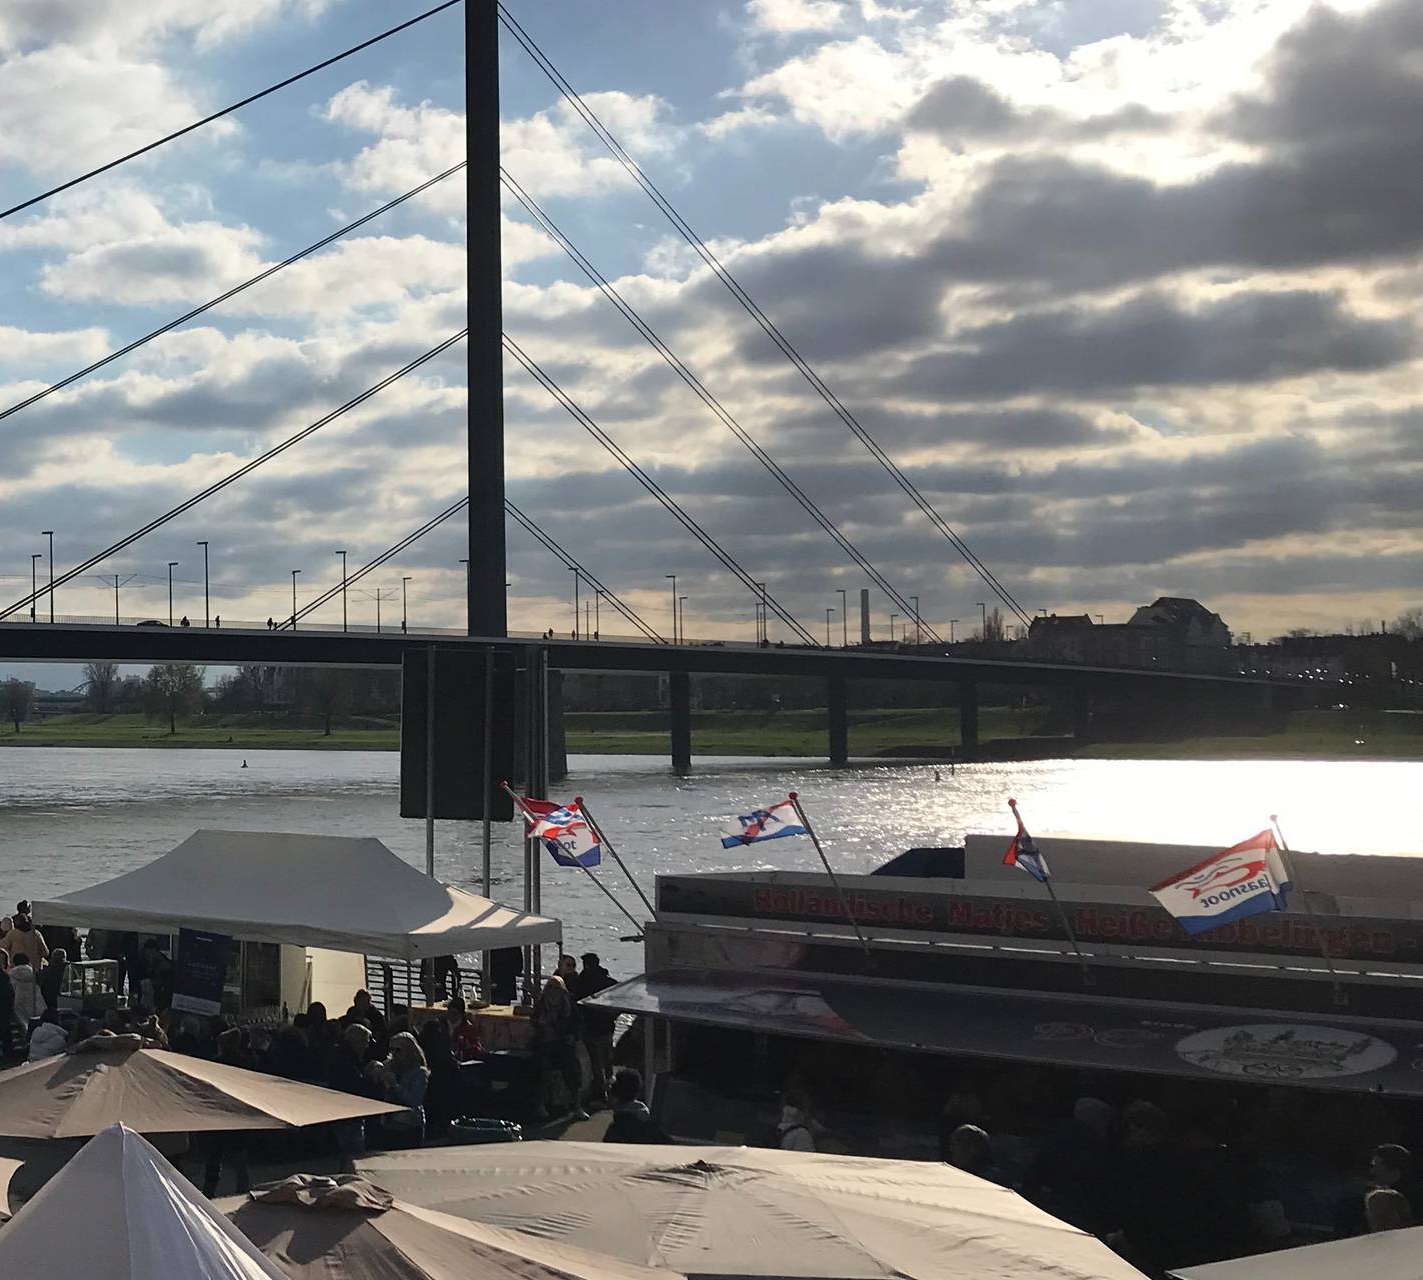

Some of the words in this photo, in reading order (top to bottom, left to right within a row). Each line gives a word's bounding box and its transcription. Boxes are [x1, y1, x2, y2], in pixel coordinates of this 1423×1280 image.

[948, 901, 1049, 932] Matjes
[1073, 910, 1171, 940] Heiße
[1183, 918, 1394, 957] ibbelingen
